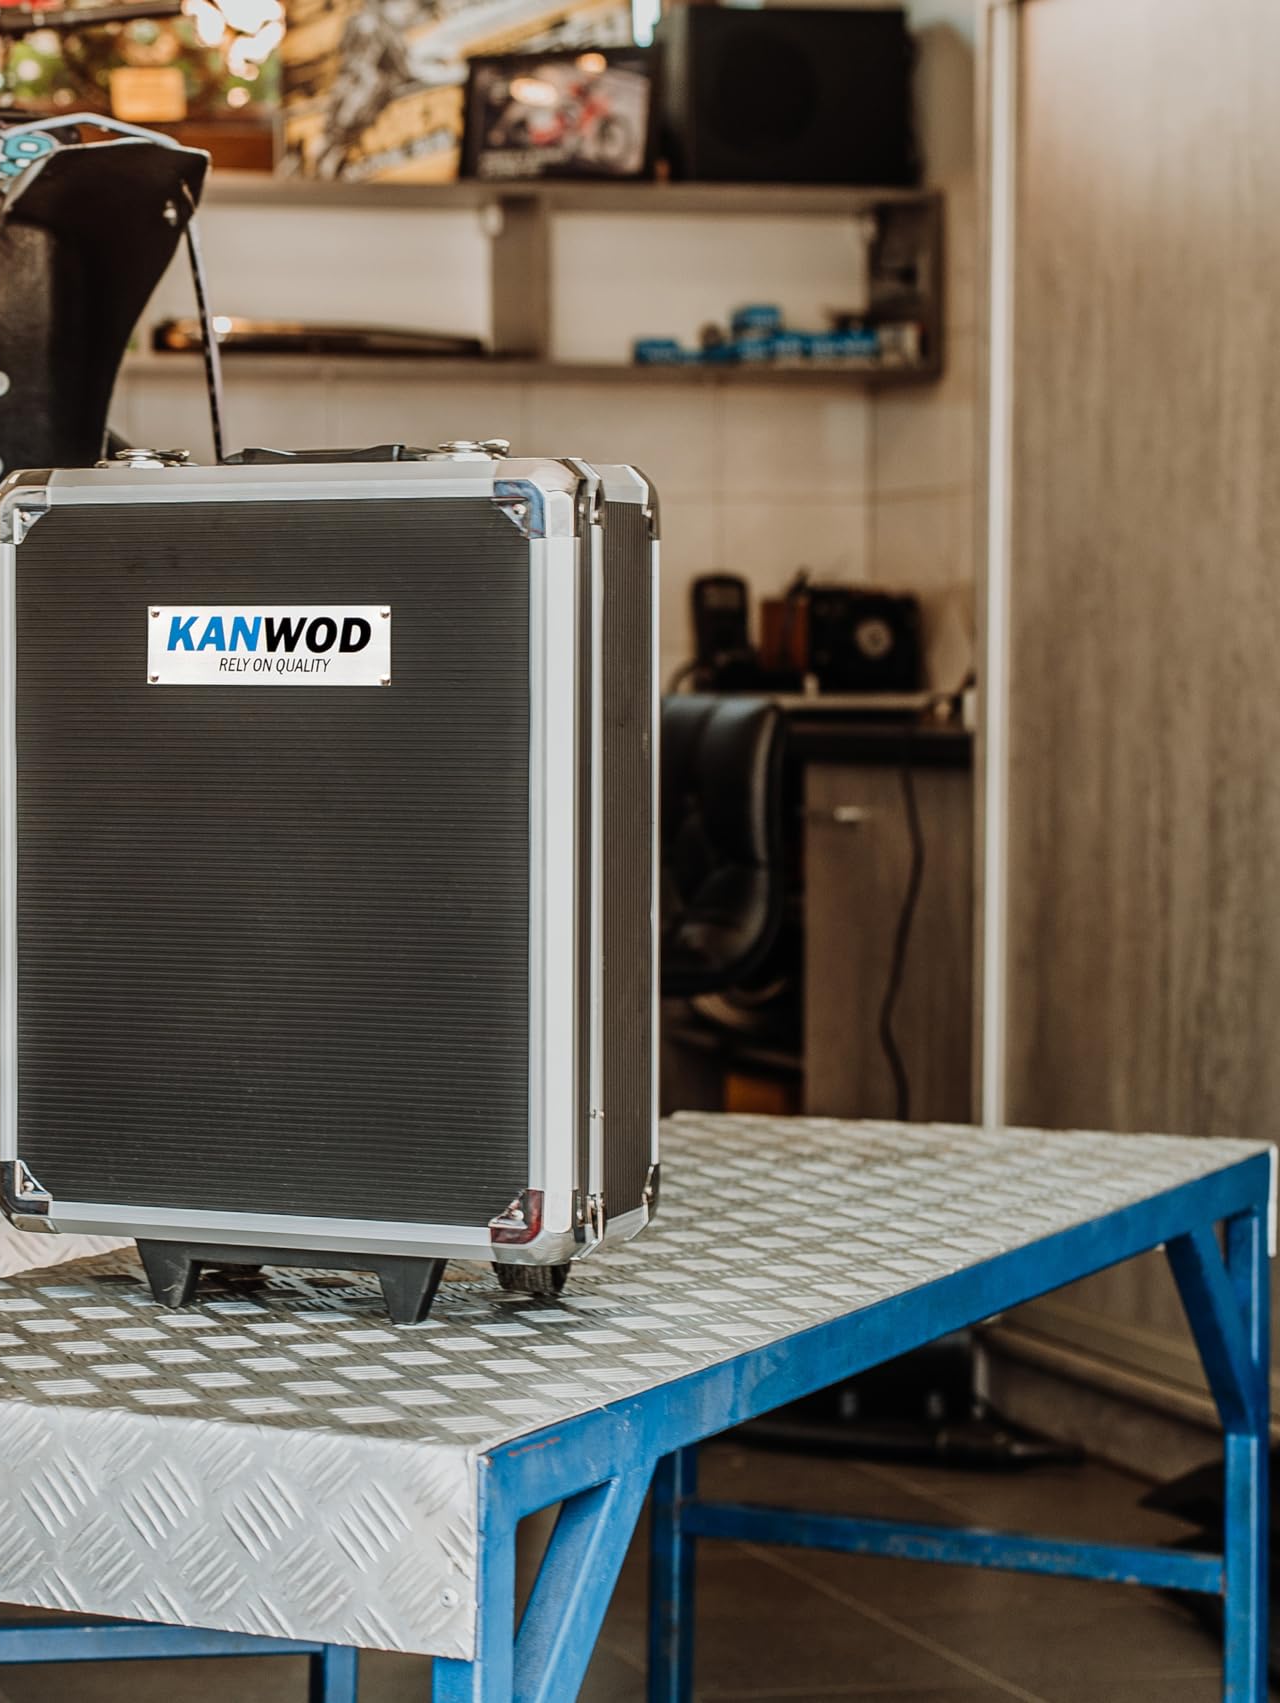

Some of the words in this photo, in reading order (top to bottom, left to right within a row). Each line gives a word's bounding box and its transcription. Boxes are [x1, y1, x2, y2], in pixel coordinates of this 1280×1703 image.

[167, 616, 372, 653] KANWOD
[219, 658, 250, 672] RELY
[253, 658, 272, 672] ON
[276, 658, 331, 673] QUALITY
